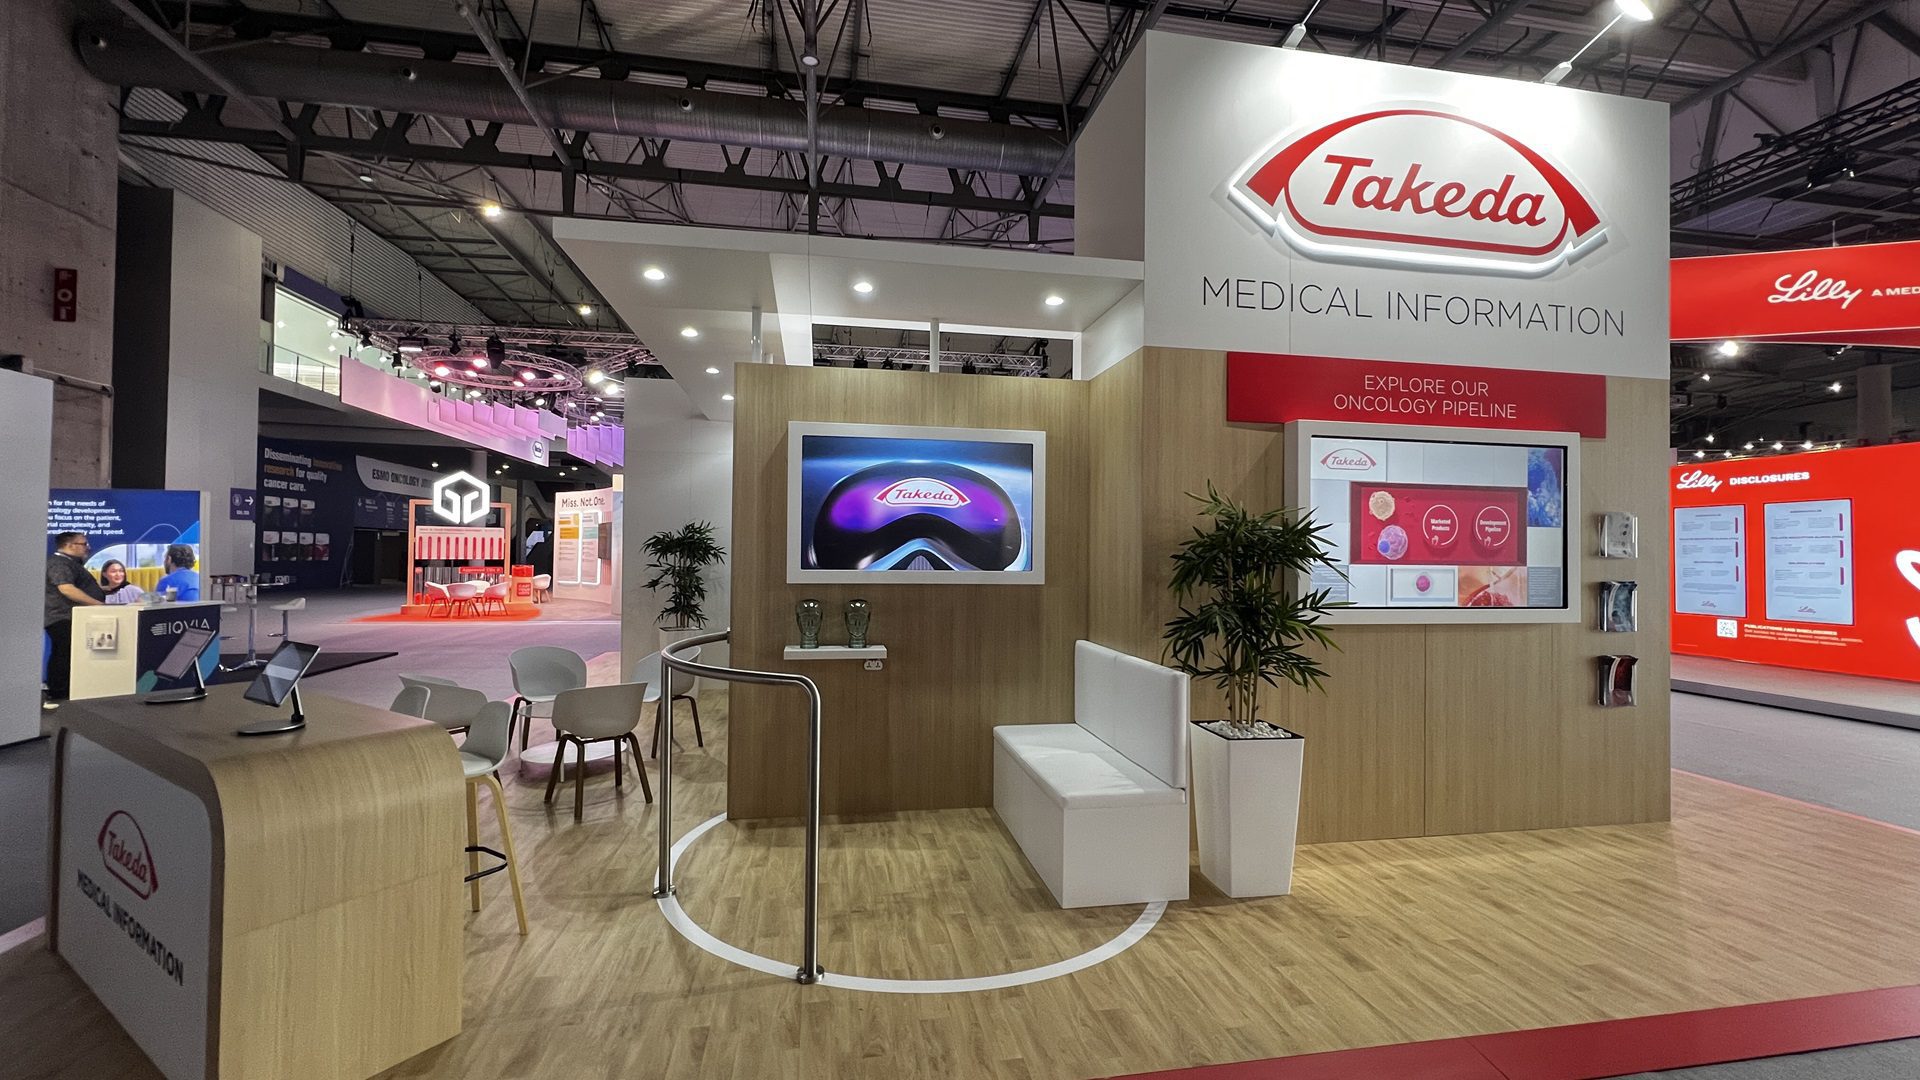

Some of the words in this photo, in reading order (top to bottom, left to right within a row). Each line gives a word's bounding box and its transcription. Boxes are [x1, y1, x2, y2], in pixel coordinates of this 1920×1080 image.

[1322, 154, 1547, 227] Takeda
[1767, 269, 1863, 309] Lilly
[1871, 288, 1883, 297] A
[1202, 275, 1373, 319] MEDICAL
[1387, 291, 1625, 337] INFORMATION
[1364, 375, 1445, 395] EXPLORE
[1451, 380, 1489, 397] OUR
[1333, 393, 1439, 415] ONCOLOGY
[1442, 400, 1517, 419] PIPELINE
[264, 447, 312, 468] Disseminating
[1331, 456, 1368, 467] Takeda
[263, 478, 288, 490] cancer
[289, 481, 306, 492] care.
[295, 467, 306, 478] for
[306, 470, 327, 484] quality
[372, 469, 390, 481] ESMO
[391, 472, 420, 487] ONCOLOGY
[1676, 470, 1722, 492] Lilly
[1729, 471, 1810, 486] DISCLOSURES
[561, 498, 579, 508] Miss.
[894, 488, 954, 501] Takeda
[107, 829, 149, 883] Takeda
[77, 868, 112, 919] MEDICAL
[112, 901, 184, 987] INFORMATION
